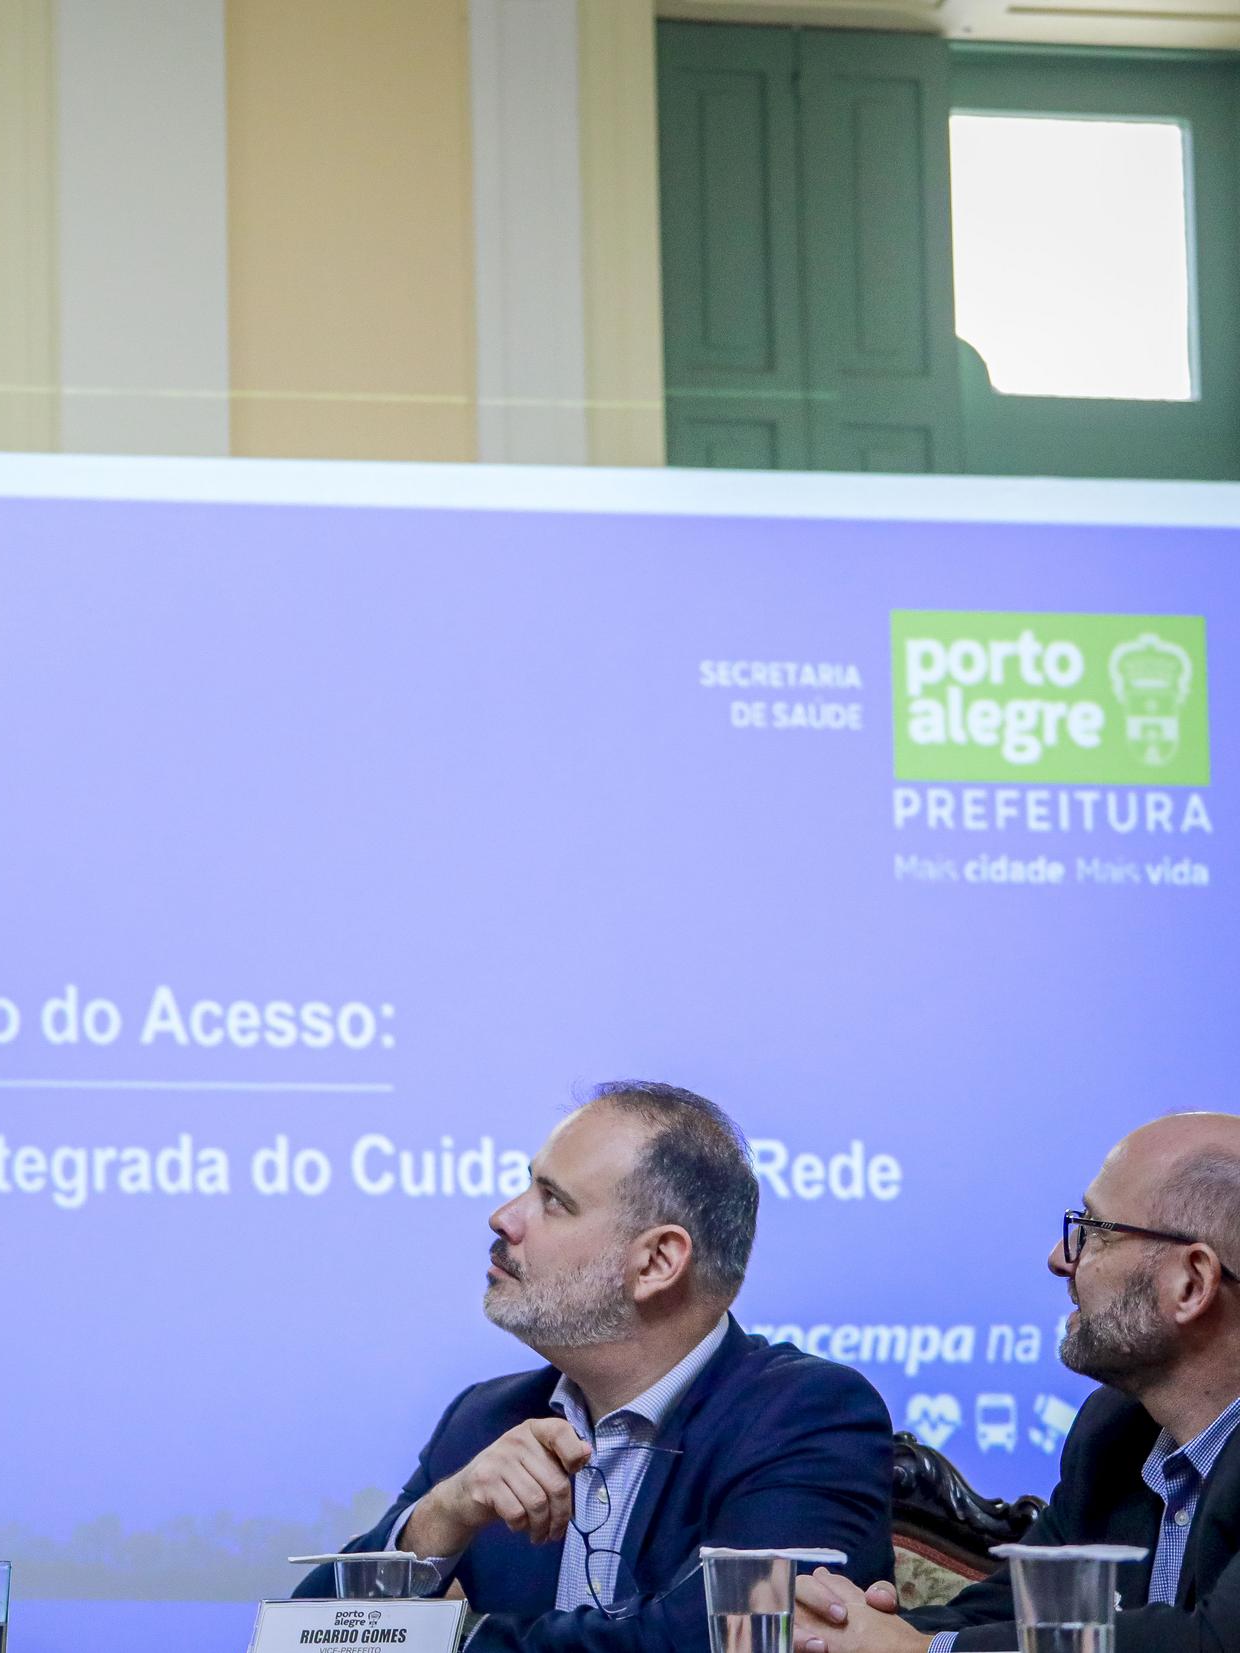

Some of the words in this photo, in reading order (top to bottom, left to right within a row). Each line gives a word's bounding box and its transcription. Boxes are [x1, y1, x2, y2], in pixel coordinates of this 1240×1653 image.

[699, 660, 862, 689] SECRETARIA
[905, 630, 1084, 696] porto
[731, 701, 766, 728] DE
[773, 697, 862, 730] SAÚDE
[907, 688, 1106, 765] alegre
[892, 787, 1213, 834] PREFEITURA
[963, 852, 1065, 885] cidade
[1144, 855, 1210, 887] vida
[41, 983, 121, 1046] do
[140, 986, 397, 1048] Acesso:
[252, 1134, 329, 1197] do
[749, 1139, 902, 1200] Rede
[986, 1324, 1041, 1362] na
[334, 1618, 366, 1628] alegre
[335, 1610, 364, 1619] porto
[300, 1629, 358, 1644] RICARDO
[361, 1628, 407, 1643] GOMES
